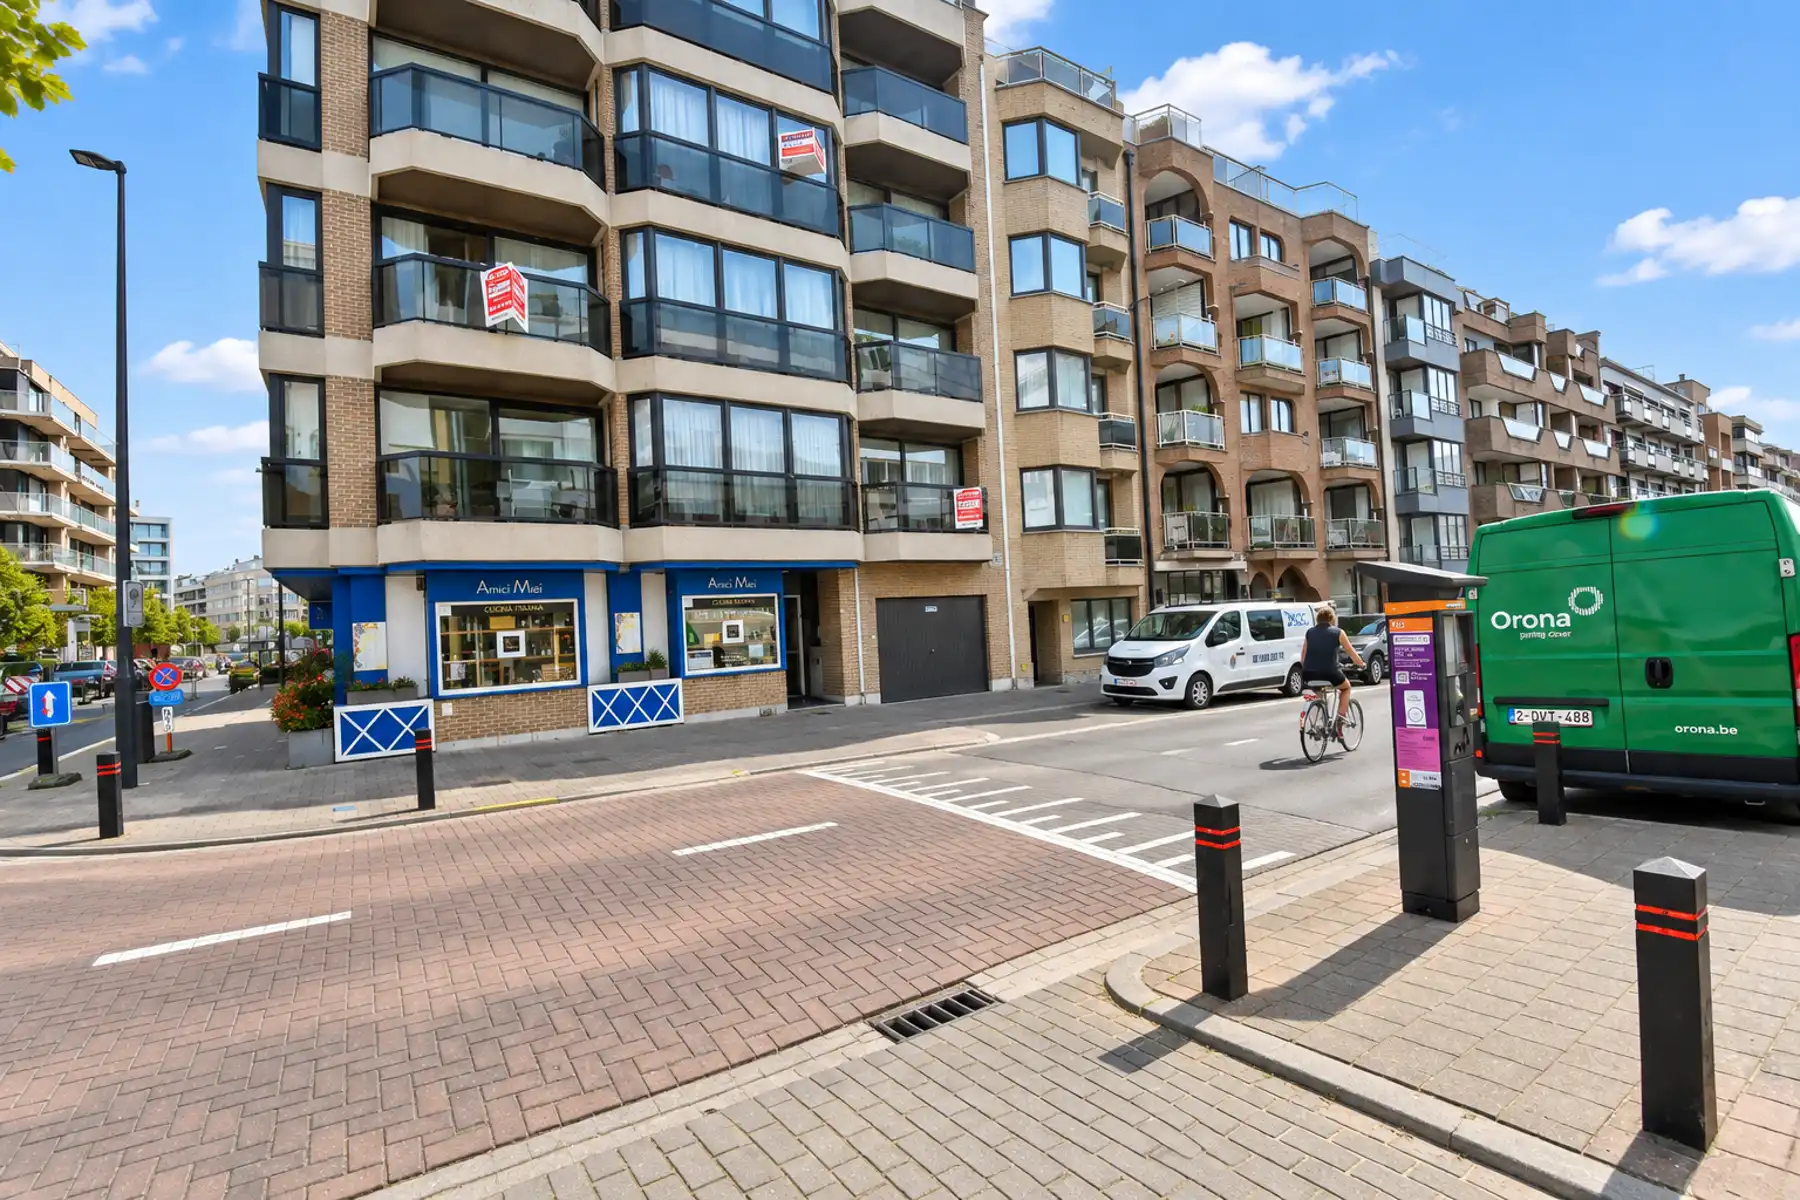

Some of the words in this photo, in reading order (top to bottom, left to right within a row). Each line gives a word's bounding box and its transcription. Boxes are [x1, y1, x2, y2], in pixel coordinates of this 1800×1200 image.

[476, 579, 510, 594] Amici
[513, 579, 543, 594] Miei
[1491, 611, 1571, 630] Orona
[1674, 724, 1738, 735] orona.be
